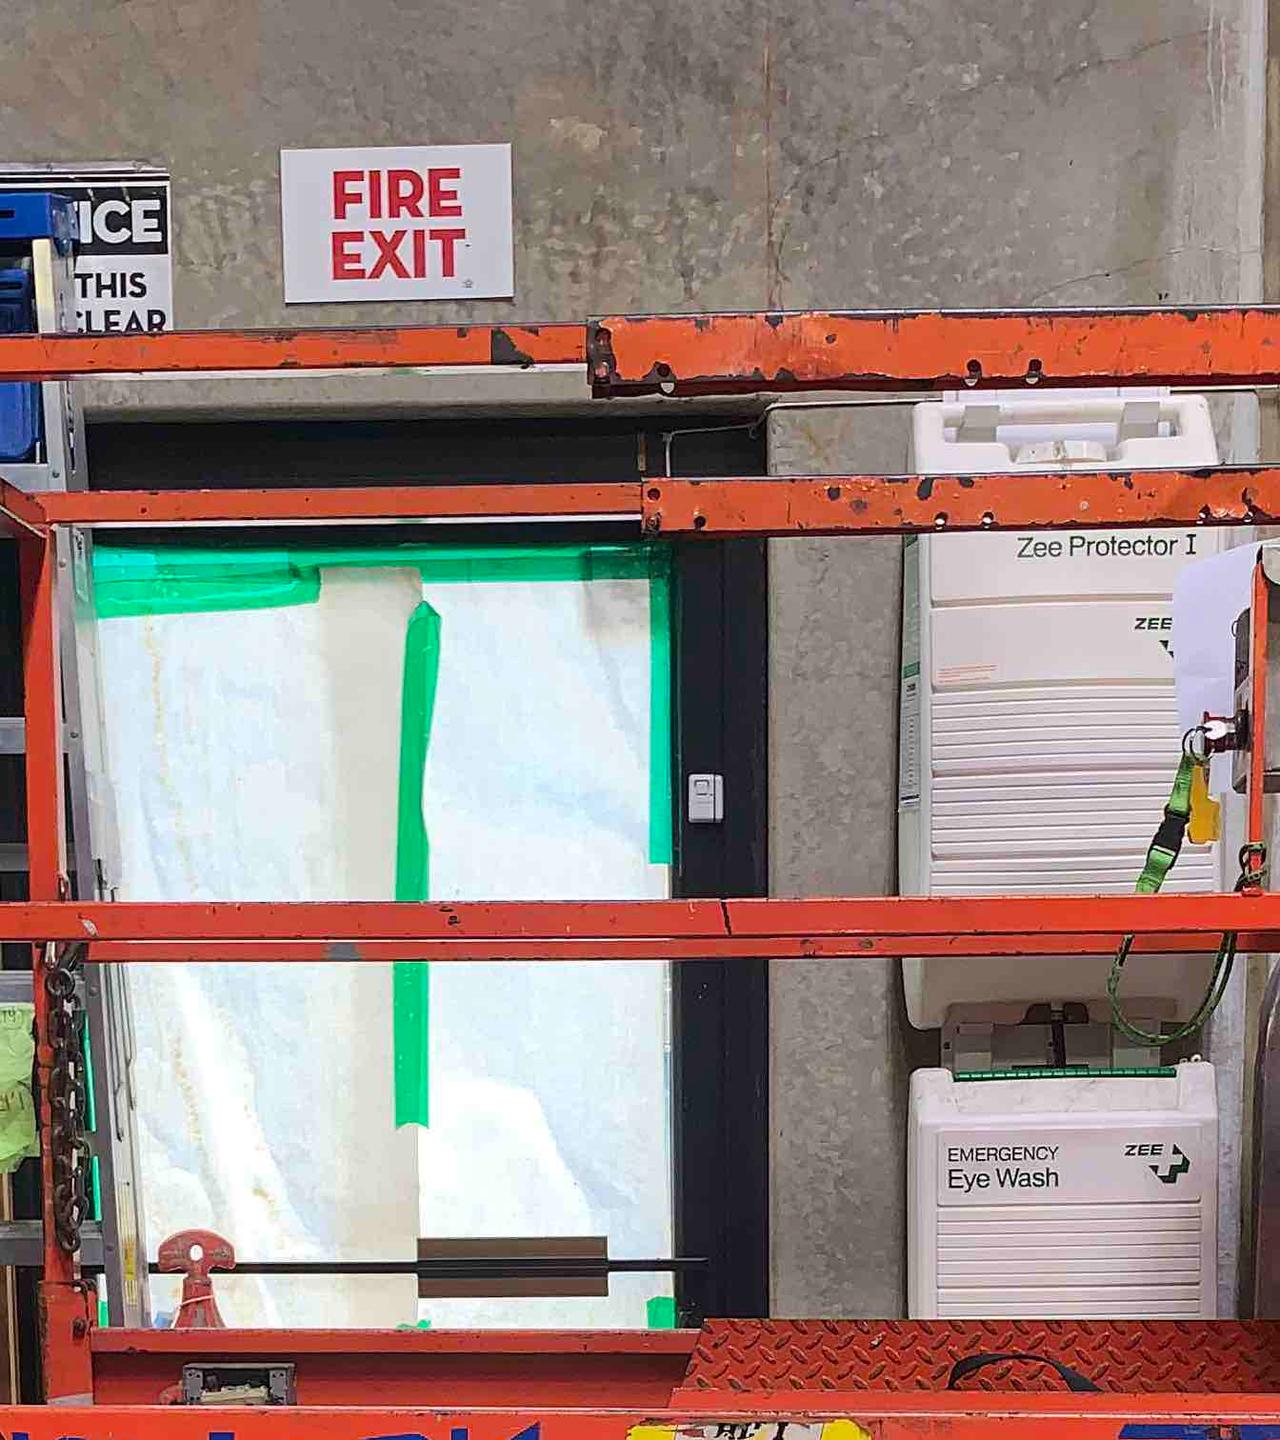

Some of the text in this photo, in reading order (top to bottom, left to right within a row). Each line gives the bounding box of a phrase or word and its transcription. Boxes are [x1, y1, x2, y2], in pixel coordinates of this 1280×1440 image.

[333, 168, 463, 219] FIRE
[74, 199, 162, 244] ICE
[331, 228, 466, 280] EXIT
[75, 272, 147, 299] THIS
[1016, 533, 1197, 558] Zee Protector I
[1134, 617, 1173, 630] ZEE
[947, 1146, 1059, 1162] EMERGENCY
[1124, 1143, 1164, 1156] ZEE
[947, 1167, 1059, 1193] Eye Wash
